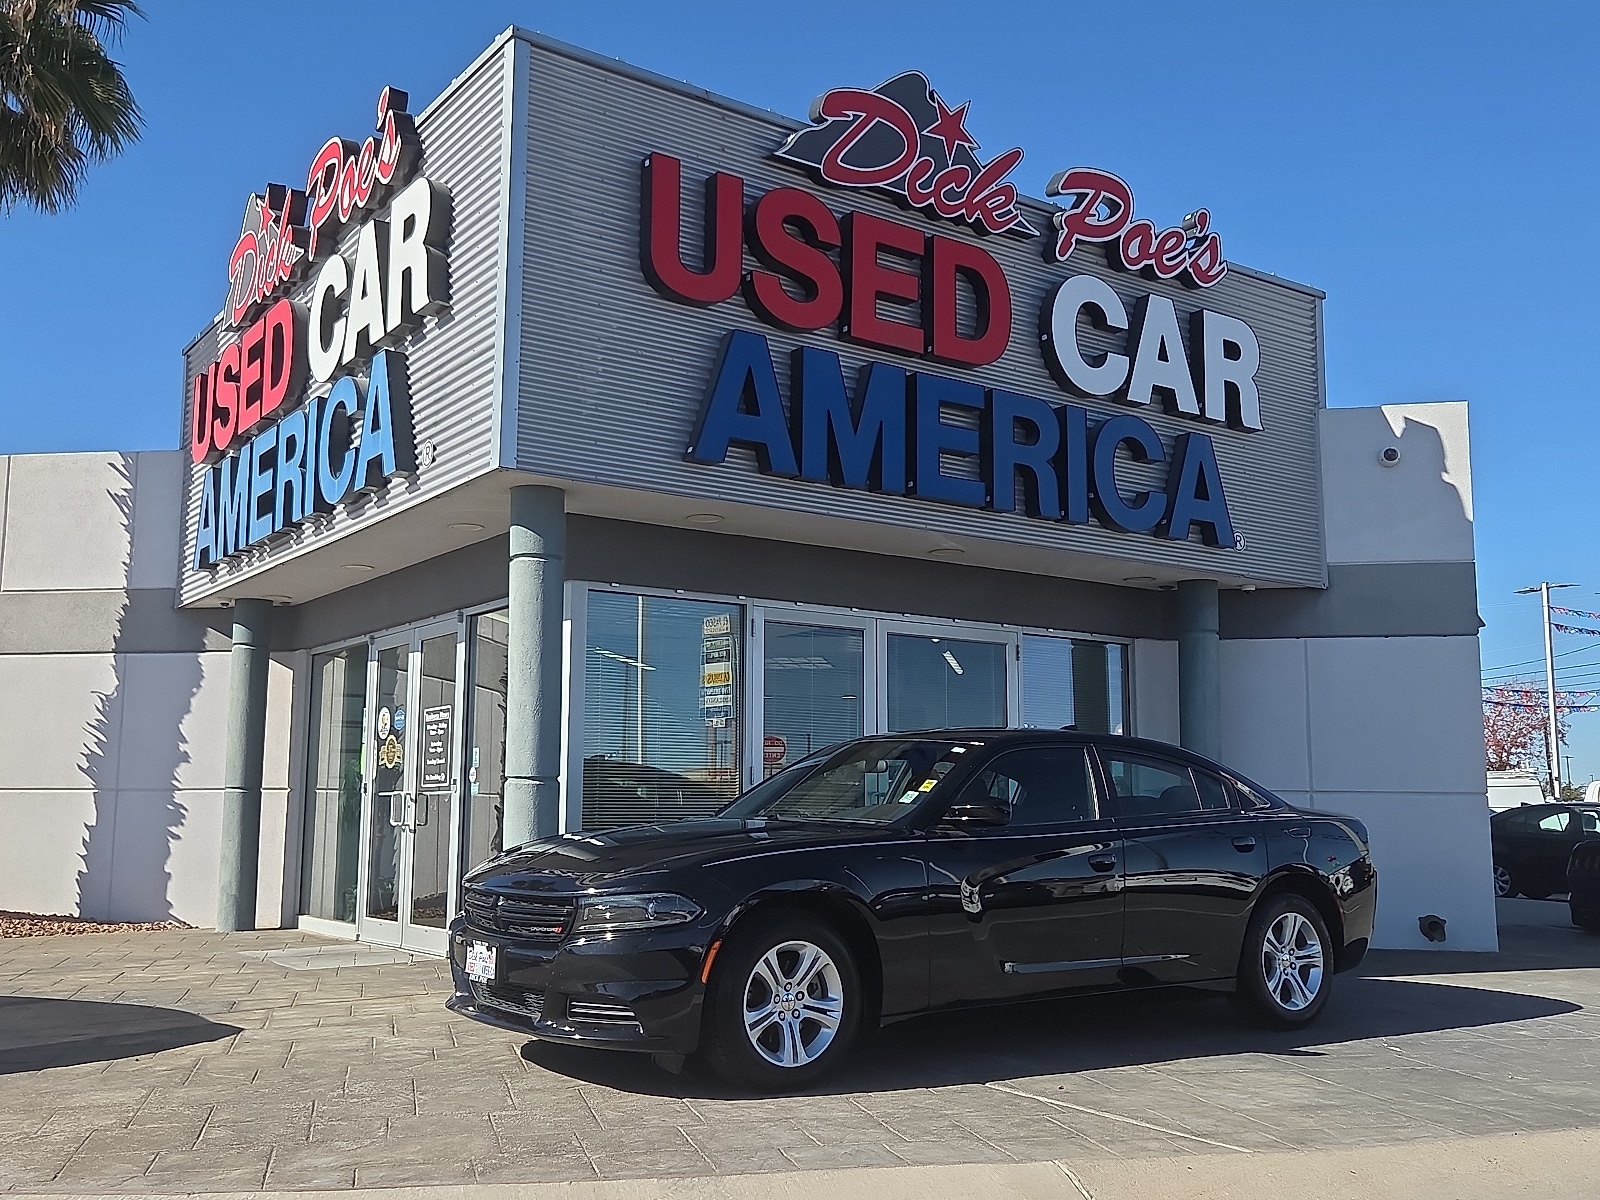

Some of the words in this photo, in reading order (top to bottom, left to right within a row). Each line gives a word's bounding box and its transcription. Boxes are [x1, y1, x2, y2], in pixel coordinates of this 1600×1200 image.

[228, 188, 293, 328] Dick
[306, 84, 402, 261] Poe's
[646, 151, 1012, 369] USED
[1047, 274, 1263, 432] CAR
[818, 86, 1024, 234] Dick
[1053, 166, 1228, 286] Poe's
[190, 298, 295, 464] USED
[308, 176, 431, 383] CAR
[193, 349, 396, 571] AMERICA
[690, 329, 1235, 550] AMERICA
